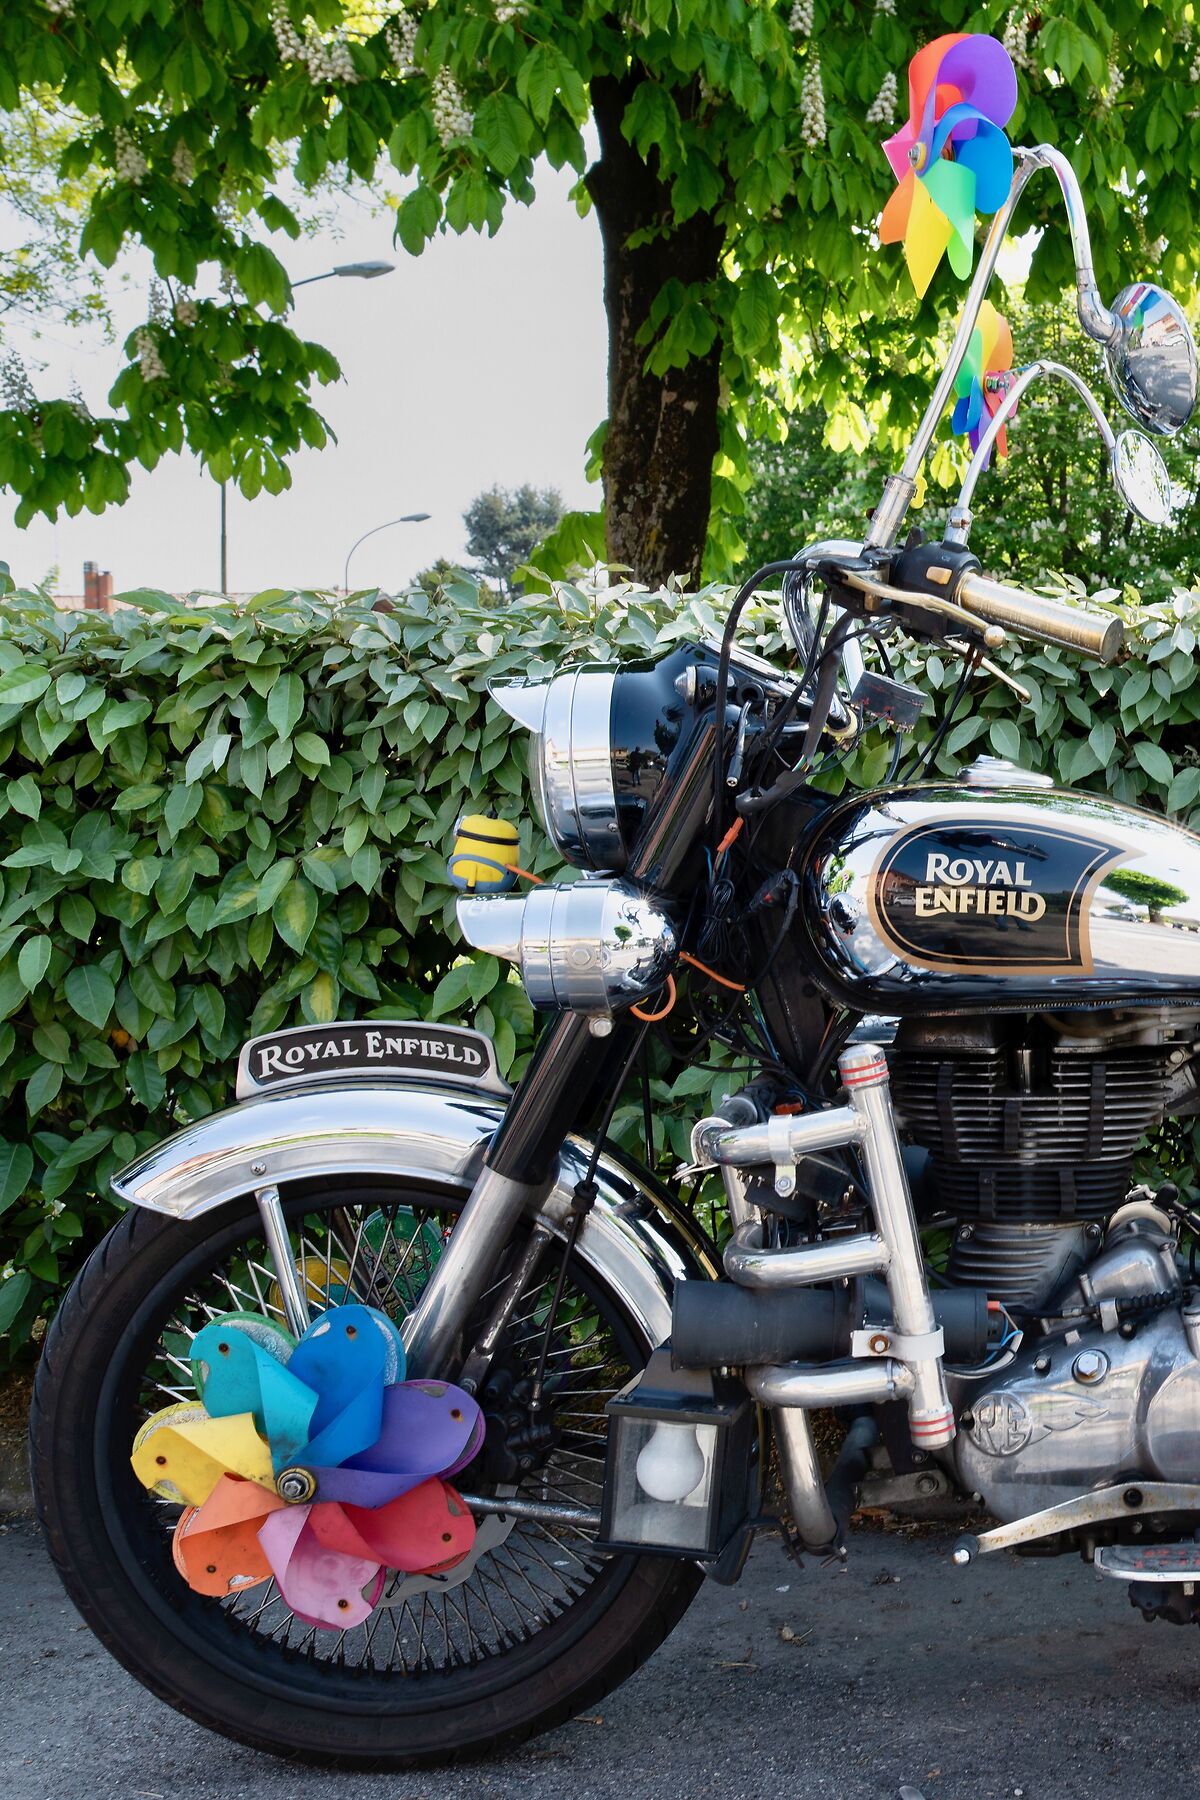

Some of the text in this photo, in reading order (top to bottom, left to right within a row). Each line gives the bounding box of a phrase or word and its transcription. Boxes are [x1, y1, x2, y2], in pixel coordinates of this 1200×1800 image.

[925, 852, 1033, 887] ROYAL
[914, 886, 1048, 923] ENFIELD
[257, 1030, 483, 1080] ROYAL ENFIELD
